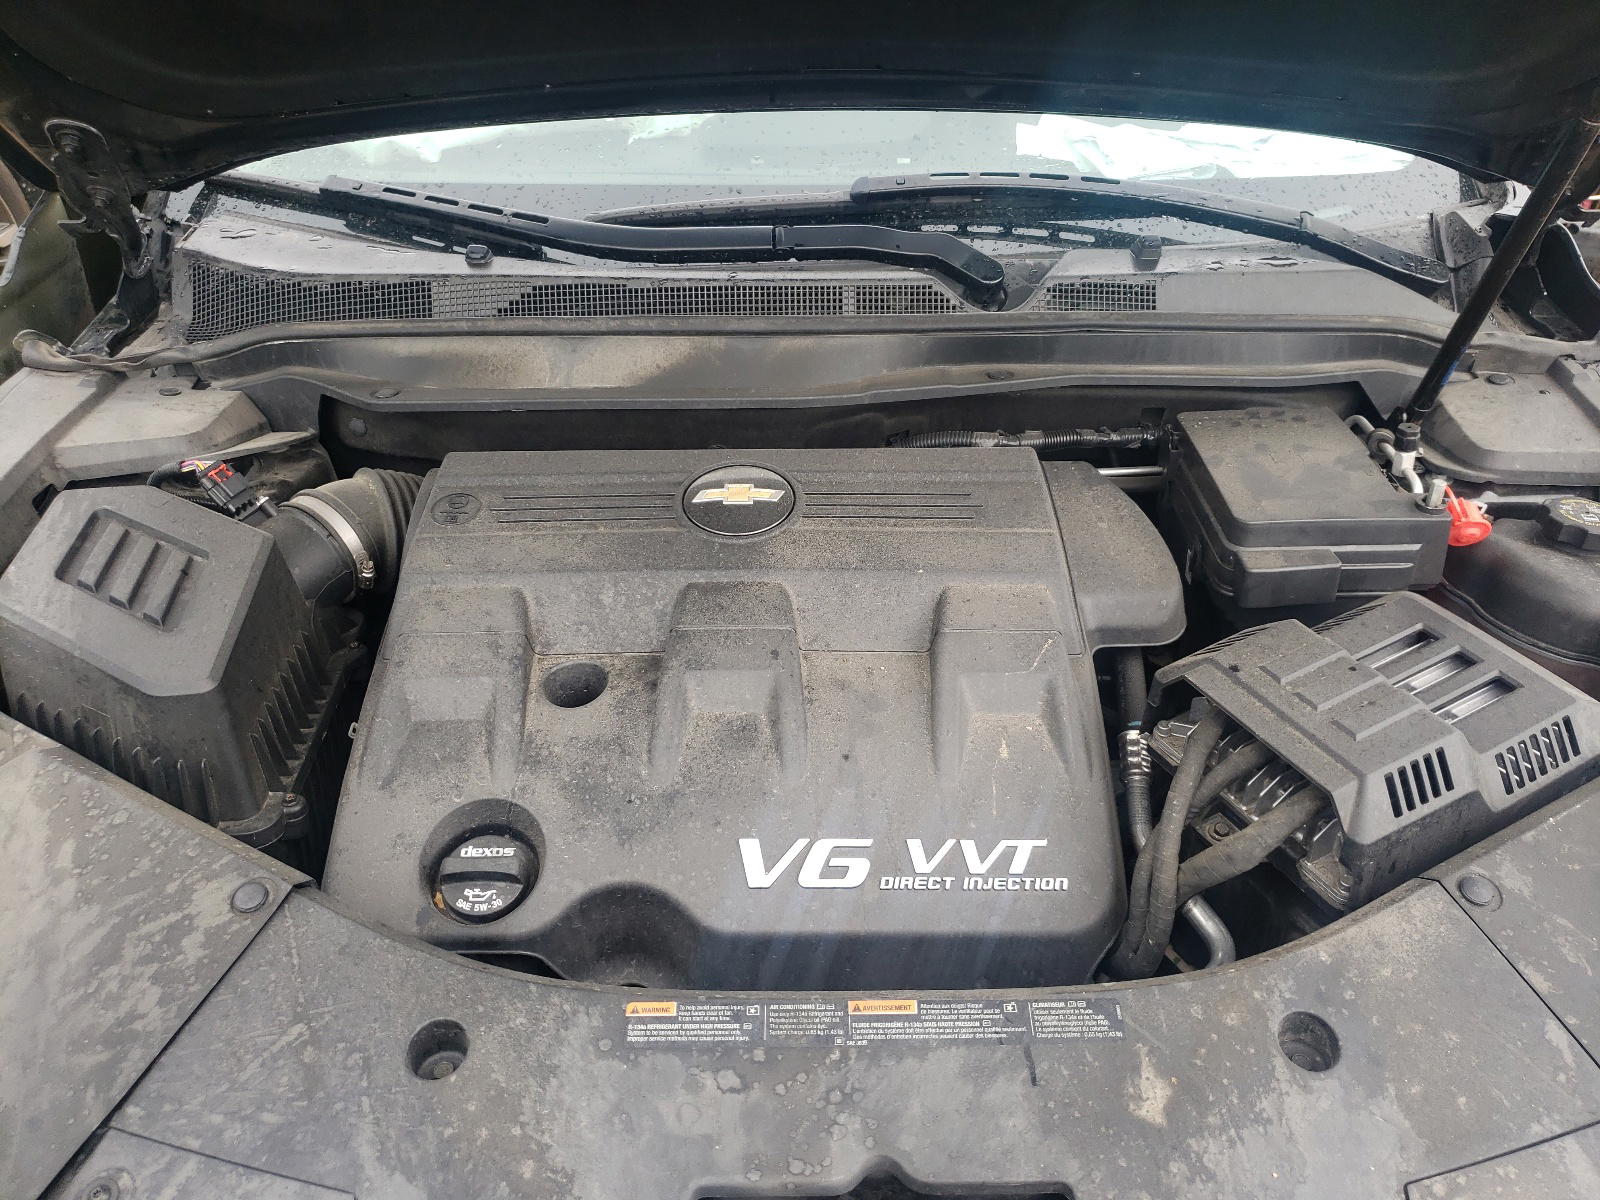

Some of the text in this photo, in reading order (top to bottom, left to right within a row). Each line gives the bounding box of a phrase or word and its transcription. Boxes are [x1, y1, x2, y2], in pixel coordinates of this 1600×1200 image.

[460, 845, 516, 858] dexos
[738, 838, 1048, 889] V6 VVT
[879, 876, 1068, 890] DIRECT INJECTION
[456, 898, 503, 912] SAE 5W-30
